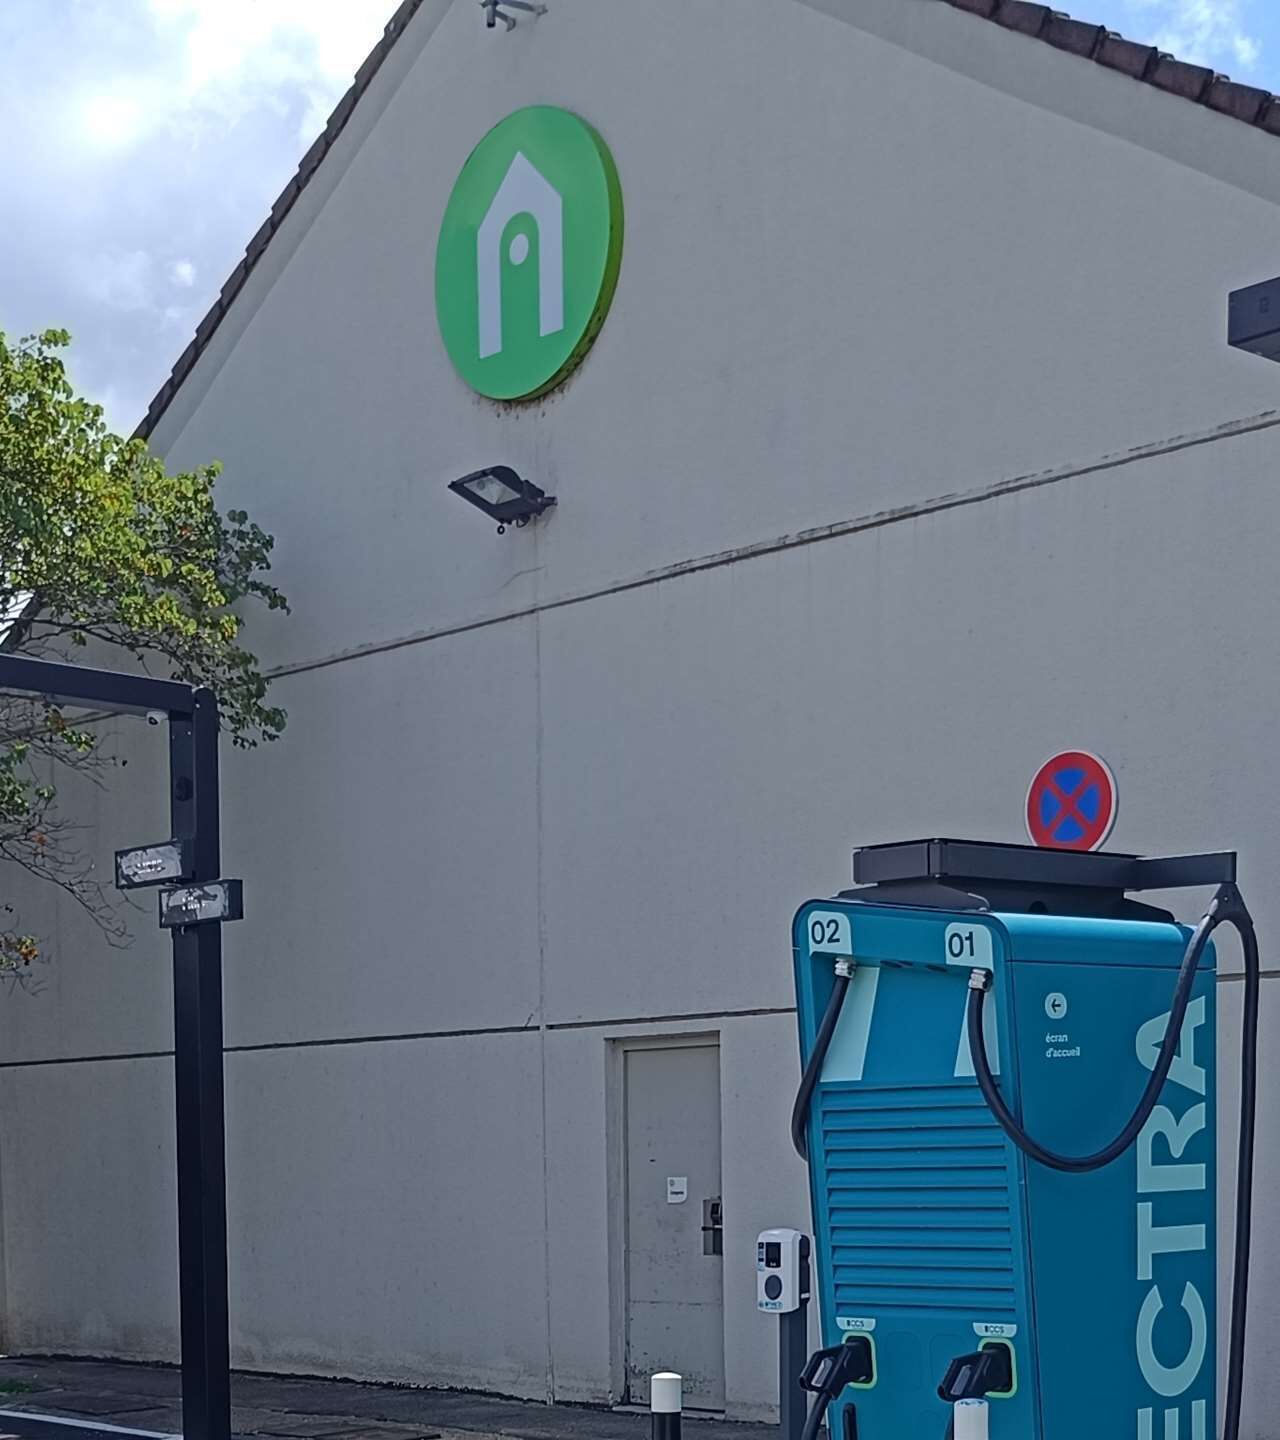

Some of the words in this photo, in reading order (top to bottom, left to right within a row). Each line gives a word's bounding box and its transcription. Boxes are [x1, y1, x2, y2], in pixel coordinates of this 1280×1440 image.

[811, 919, 841, 945] 02
[948, 931, 975, 958] 01
[1045, 1032, 1068, 1043] écran
[1045, 1046, 1081, 1058] d'accueil
